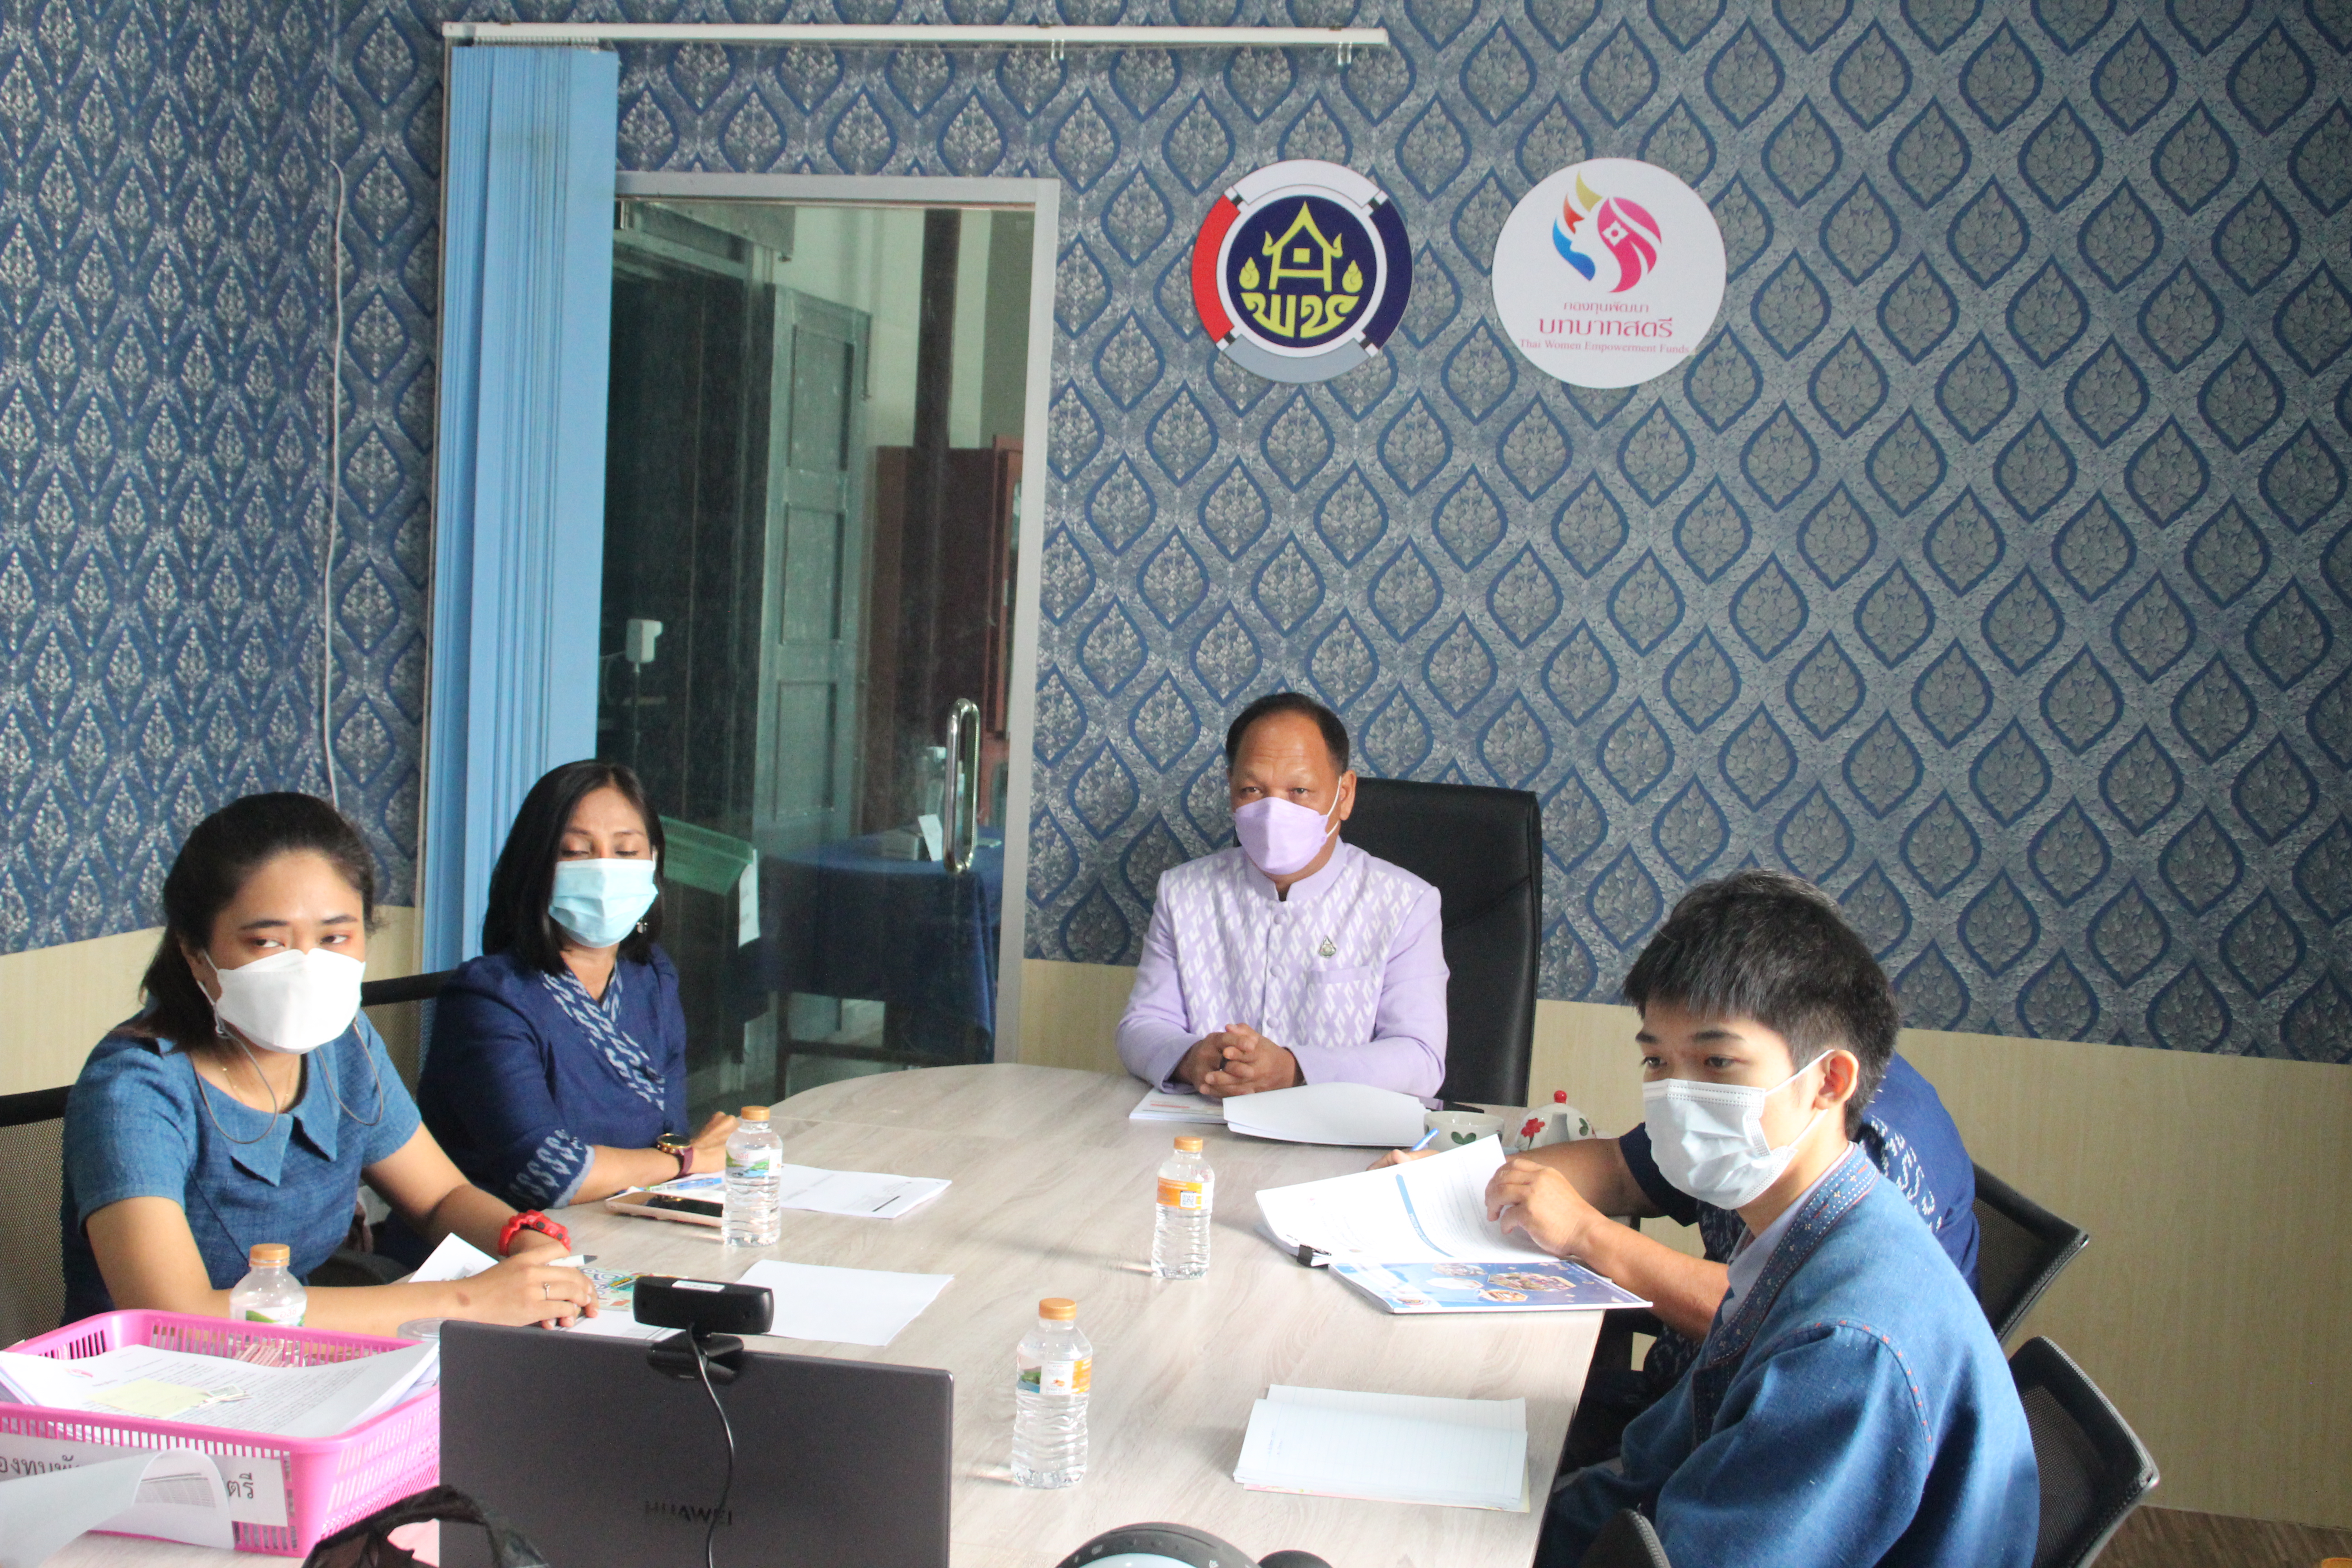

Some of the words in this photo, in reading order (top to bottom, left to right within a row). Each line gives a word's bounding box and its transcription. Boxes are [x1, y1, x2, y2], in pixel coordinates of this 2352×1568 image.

[1563, 300, 1649, 314] กองทุนพัฒนา
[1539, 317, 1673, 338] บทบาทสตรี
[1519, 338, 1541, 348] Thai
[1545, 339, 1581, 350] Women
[1585, 341, 1656, 353] Empowerment
[1660, 344, 1689, 354] Funds
